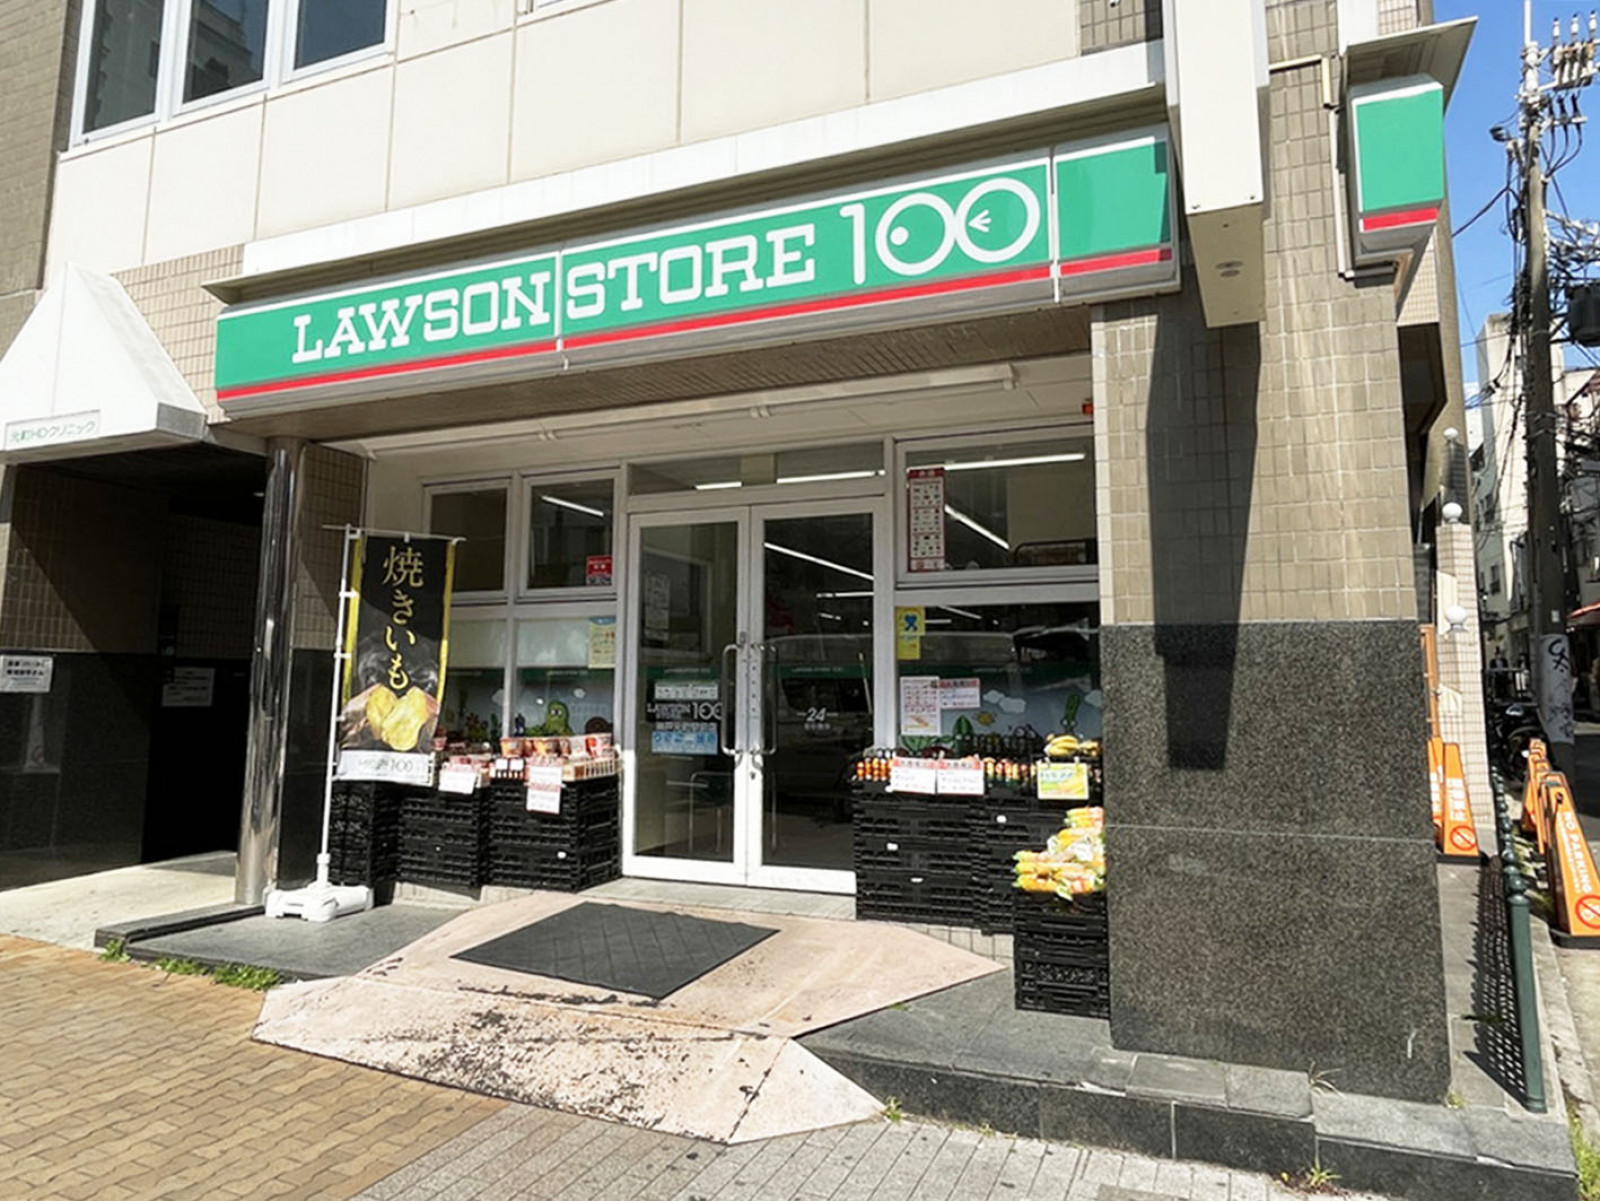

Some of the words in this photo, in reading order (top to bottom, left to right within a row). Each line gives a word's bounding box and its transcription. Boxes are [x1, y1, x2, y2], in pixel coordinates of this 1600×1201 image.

[292, 271, 551, 364] LAWSON
[566, 222, 815, 320] STORE
[840, 177, 1041, 286] 100
[382, 545, 425, 690] 焼きいも
[806, 706, 827, 722] 24
